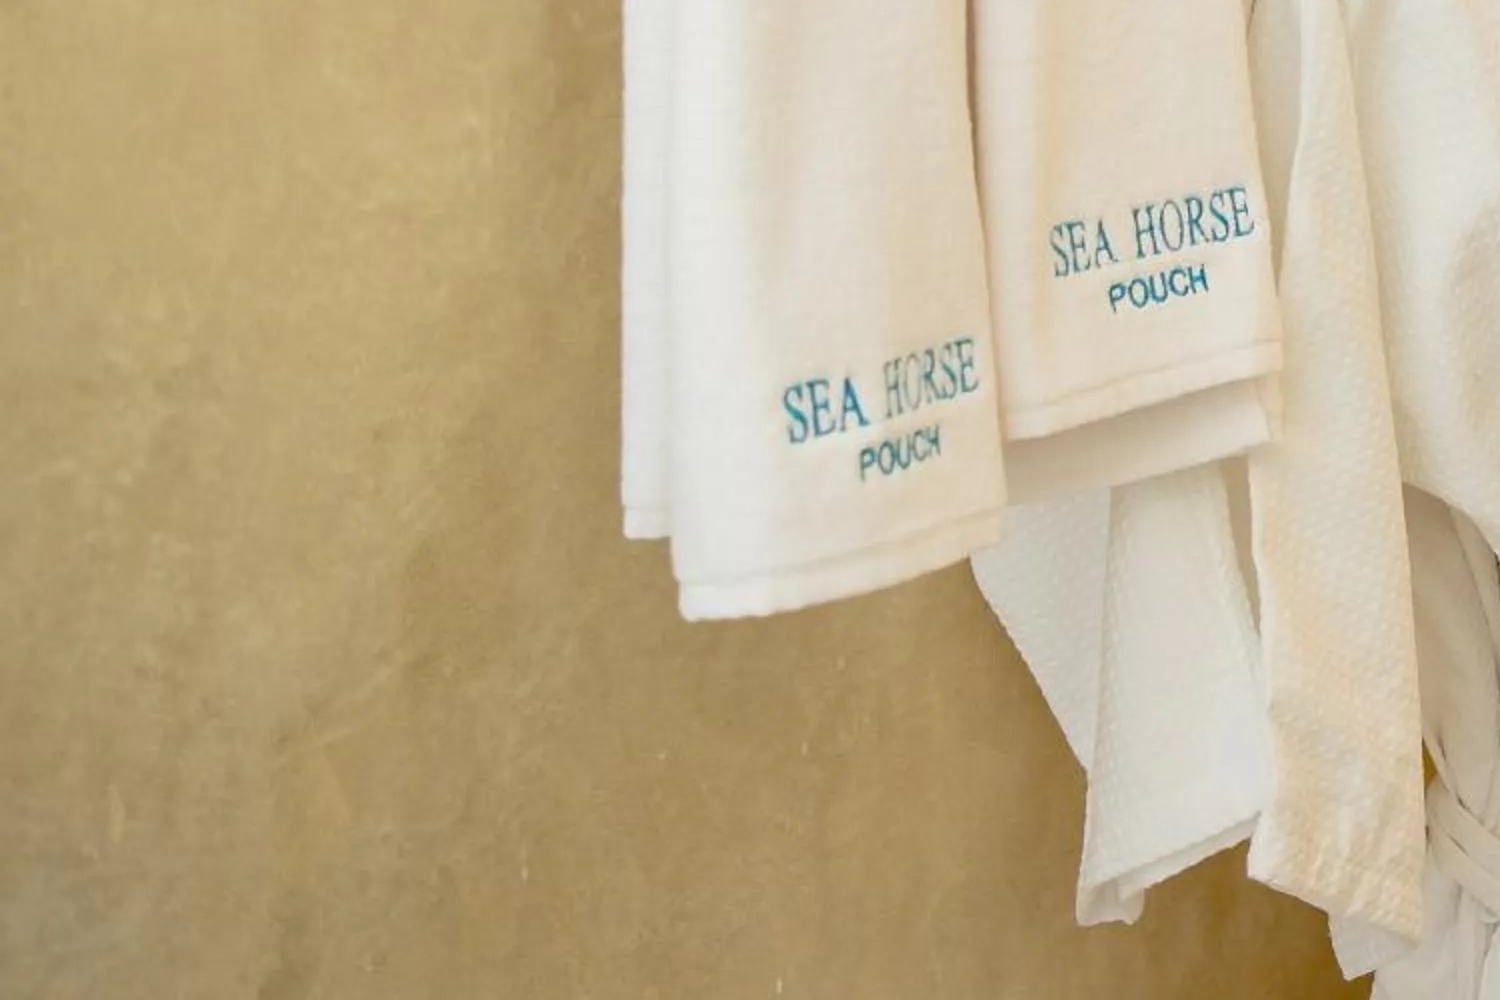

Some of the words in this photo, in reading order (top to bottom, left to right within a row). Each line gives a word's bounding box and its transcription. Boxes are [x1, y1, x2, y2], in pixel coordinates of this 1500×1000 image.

[1049, 217, 1120, 279] SEA
[1132, 186, 1256, 260] HORSE
[1107, 263, 1210, 314] POUCH
[781, 375, 871, 445] SEA
[882, 337, 980, 419] HORSE
[859, 424, 942, 482] POUCH
